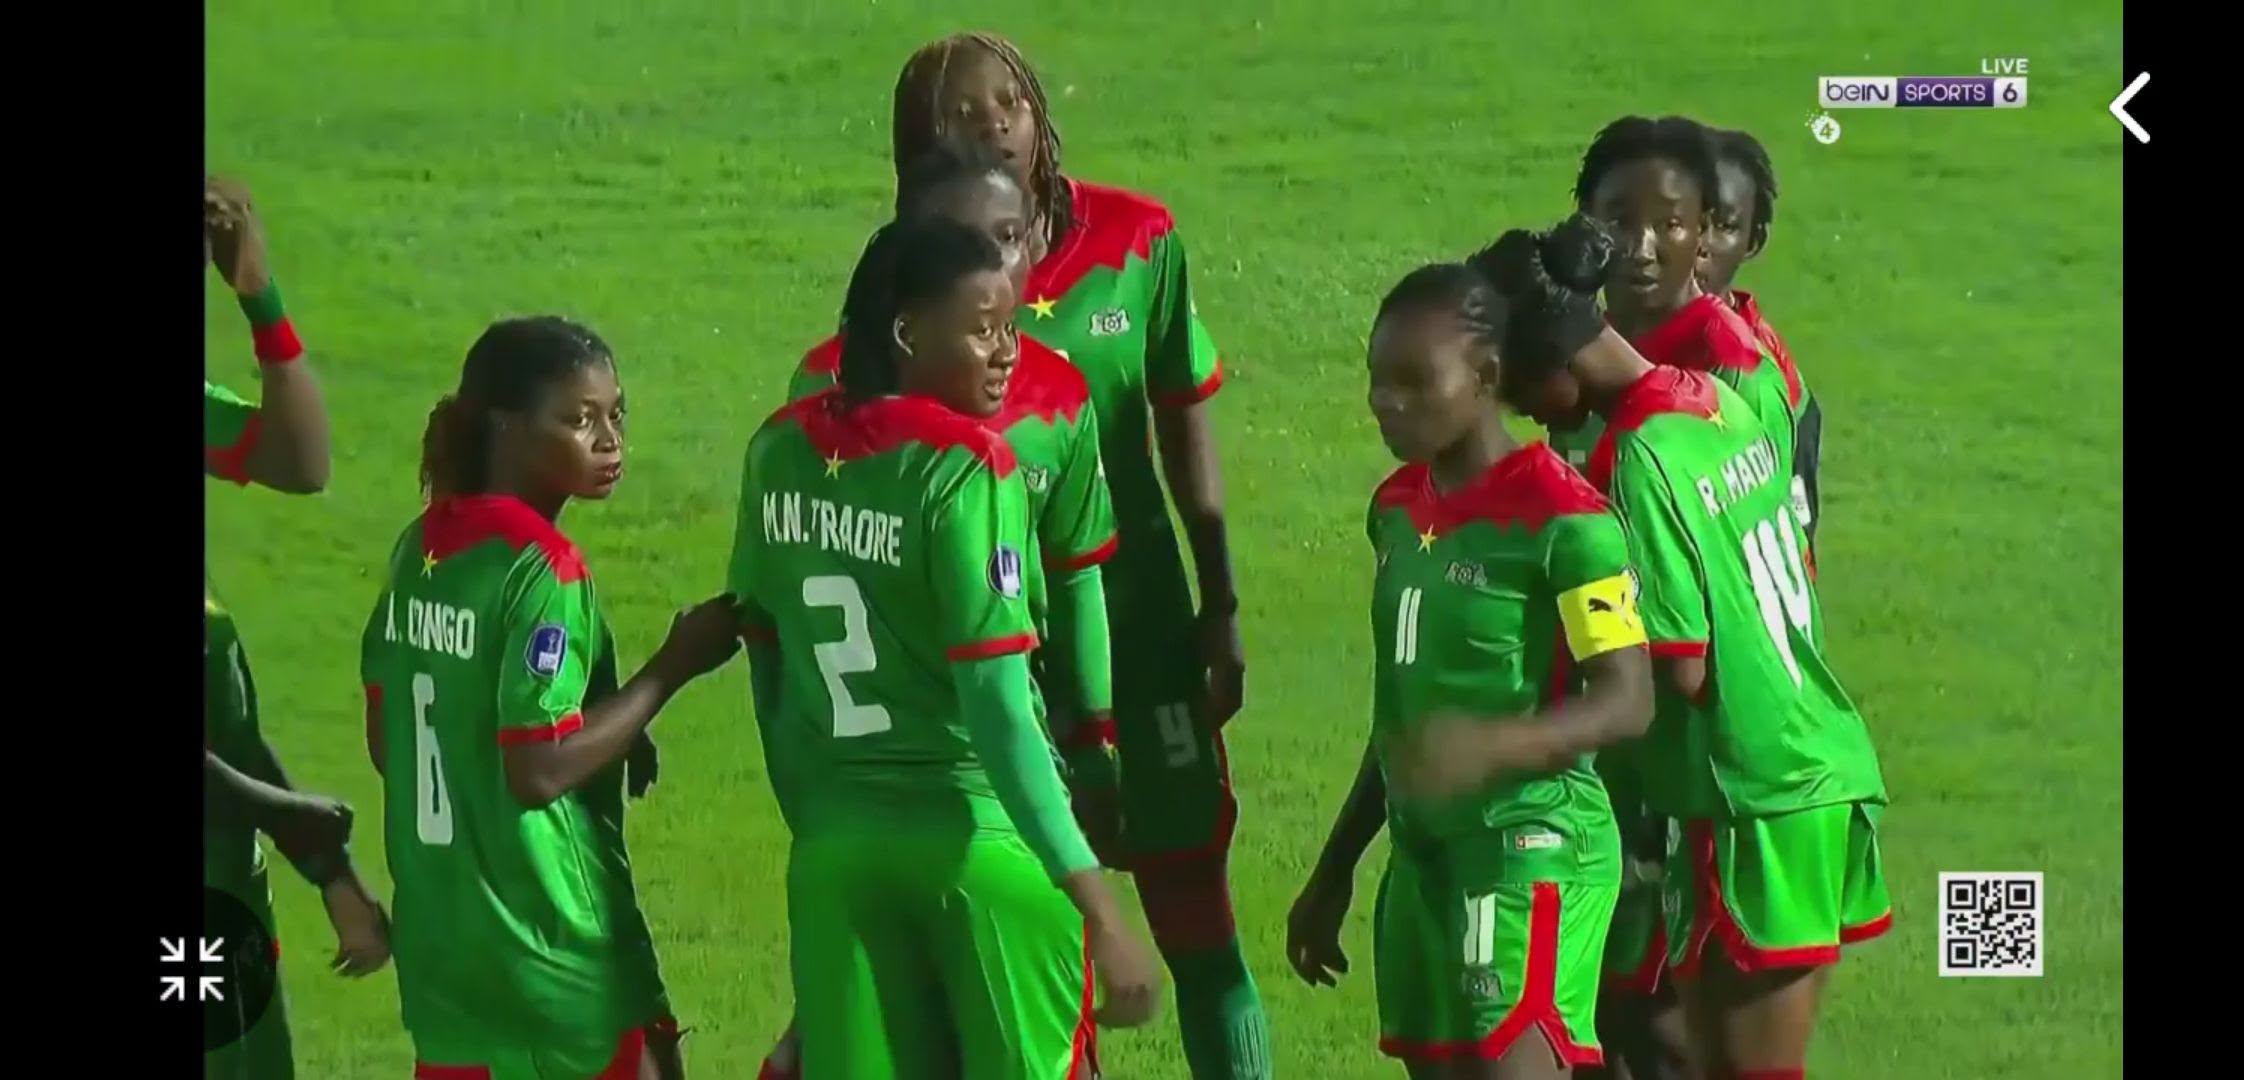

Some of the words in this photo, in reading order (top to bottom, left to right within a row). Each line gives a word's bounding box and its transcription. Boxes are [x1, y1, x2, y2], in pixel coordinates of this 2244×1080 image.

[802, 575, 892, 738] 2
[1395, 586, 1422, 665] 11
[412, 672, 453, 844] 6
[1464, 893, 1496, 965] 11
